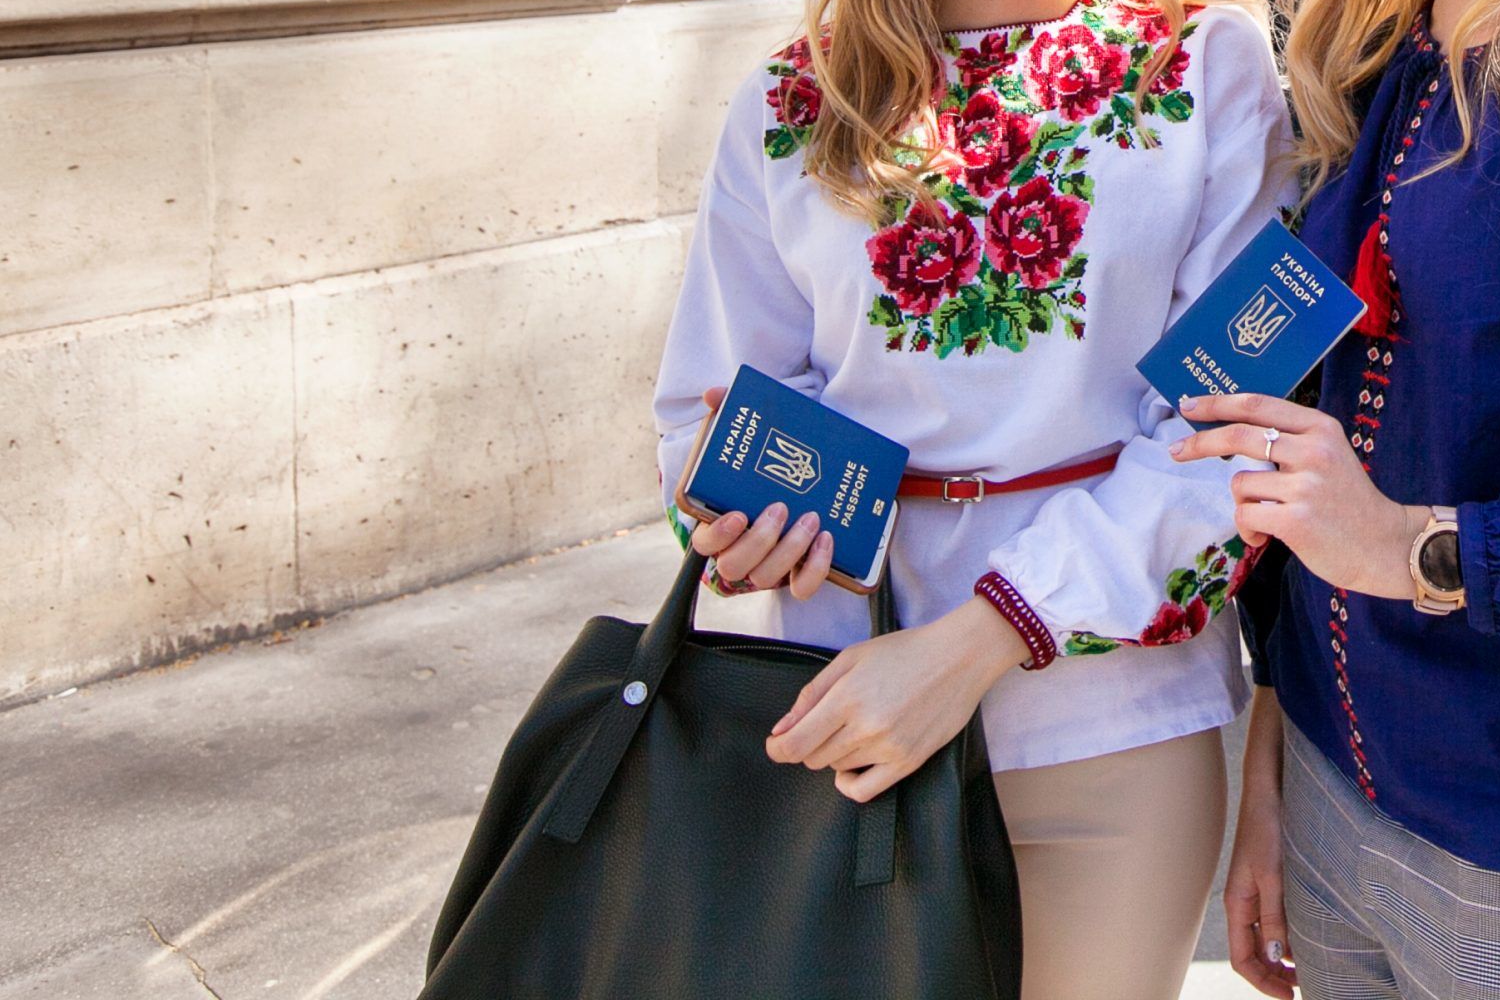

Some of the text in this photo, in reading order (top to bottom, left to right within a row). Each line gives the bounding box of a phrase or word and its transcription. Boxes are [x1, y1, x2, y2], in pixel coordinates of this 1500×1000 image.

[1270, 263, 1317, 308] ПАСПОРТ
[1280, 252, 1325, 299] УКРАЇНА
[1194, 346, 1239, 394] UKRAINE
[718, 406, 750, 464] УКРАЇНА
[731, 411, 762, 471] ПАСПОРТ
[829, 460, 858, 519] UKRAINE
[841, 465, 870, 528] PASSPORT
